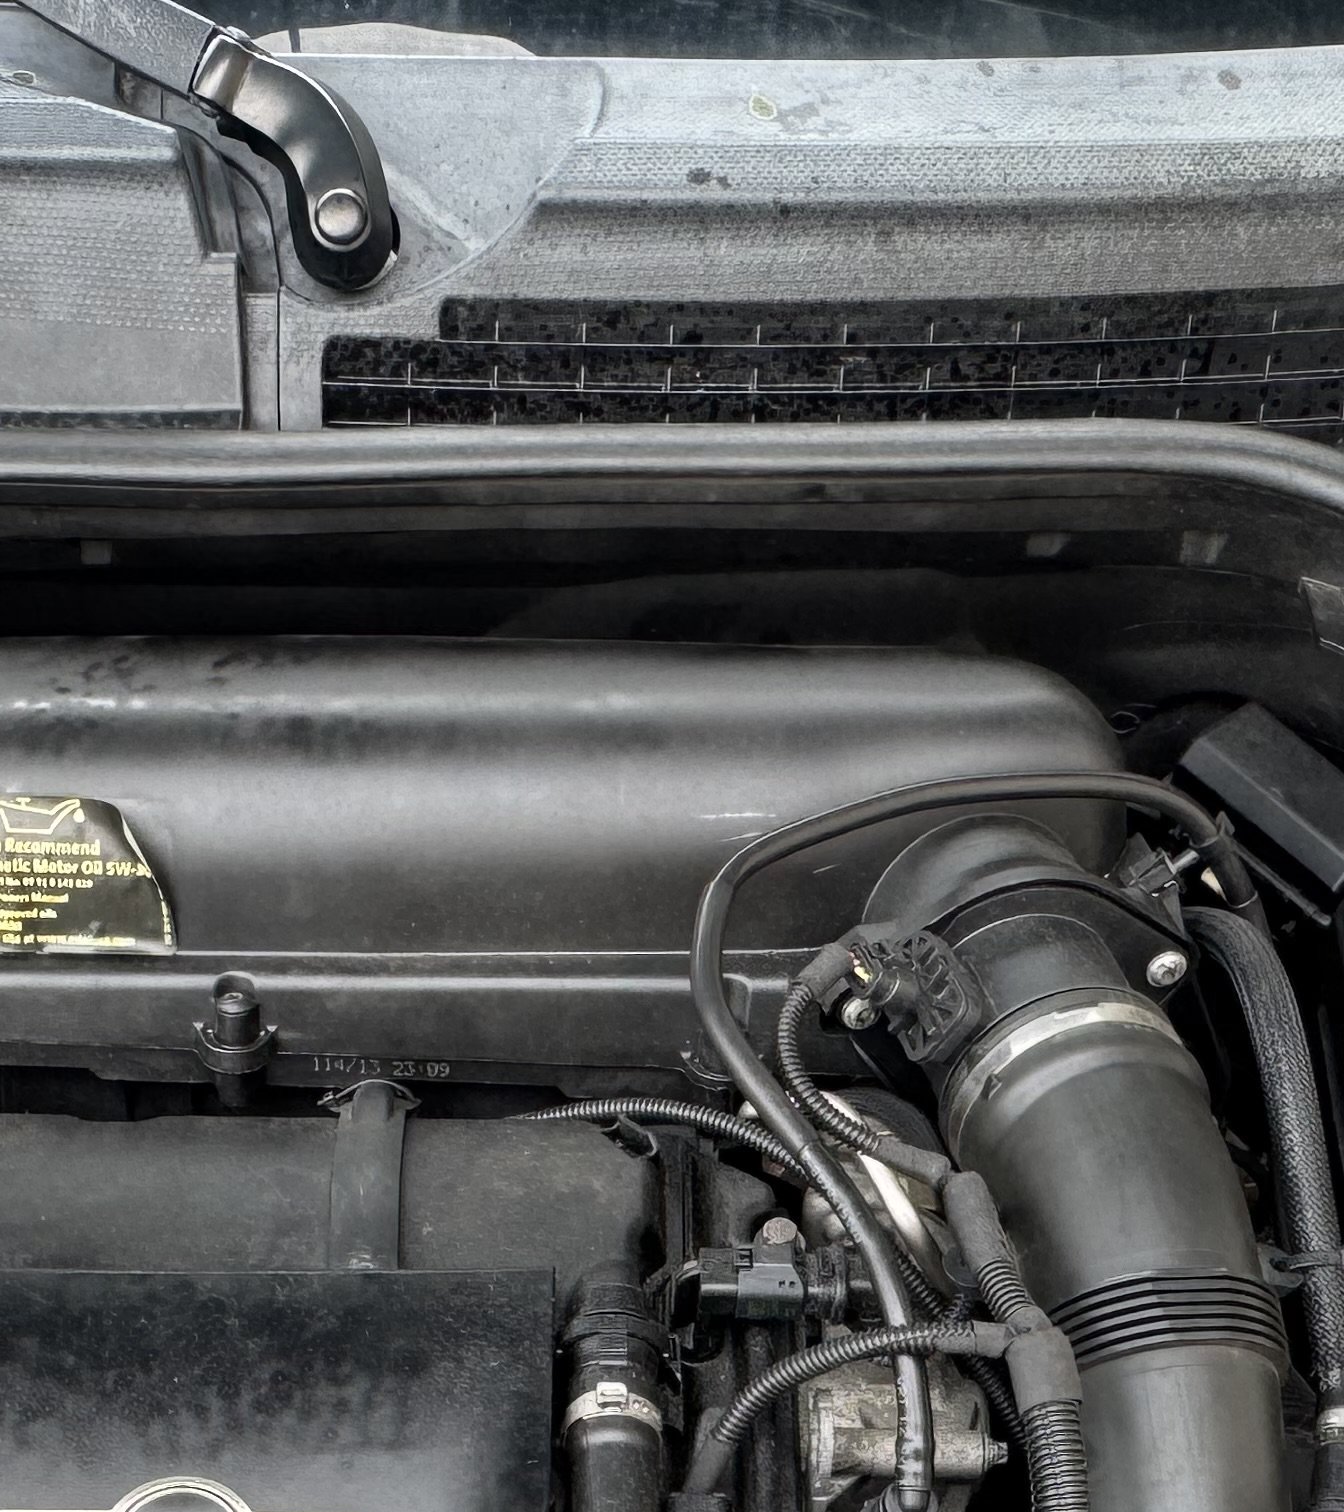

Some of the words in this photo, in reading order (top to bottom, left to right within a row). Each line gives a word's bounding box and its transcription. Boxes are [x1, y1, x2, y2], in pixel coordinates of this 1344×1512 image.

[5, 837, 100, 856] Recommend
[33, 858, 78, 874] Motor
[81, 859, 103, 875] Oil
